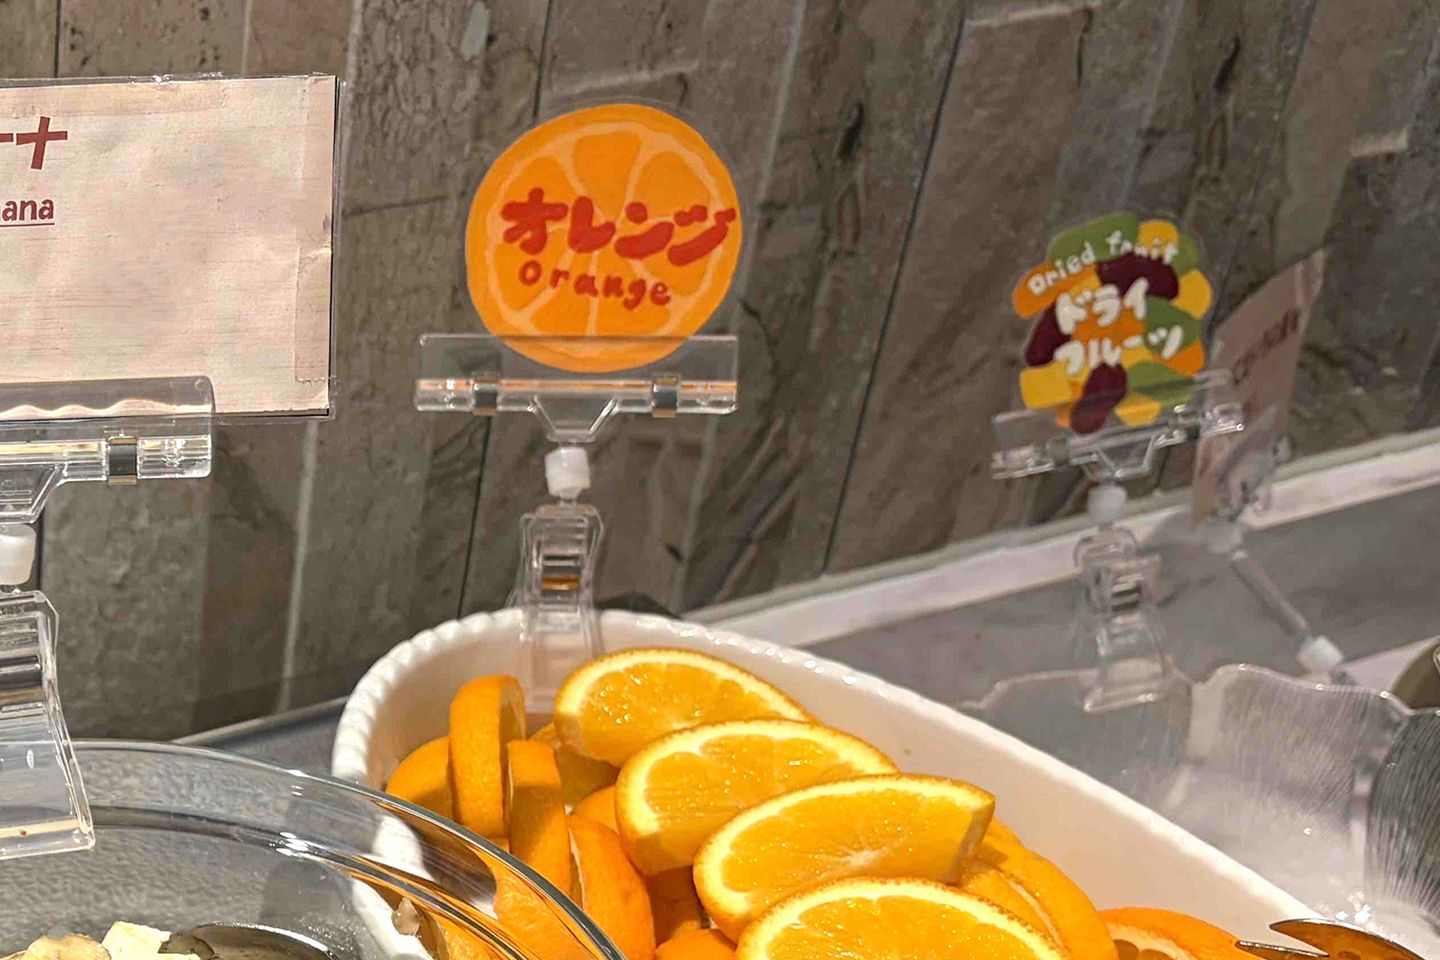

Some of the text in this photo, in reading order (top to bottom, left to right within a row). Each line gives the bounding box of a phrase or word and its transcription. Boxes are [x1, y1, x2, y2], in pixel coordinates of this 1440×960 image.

[501, 188, 737, 267] オレンジ
[1055, 276, 1149, 335] ドライ
[1053, 325, 1184, 375] フルーツ
